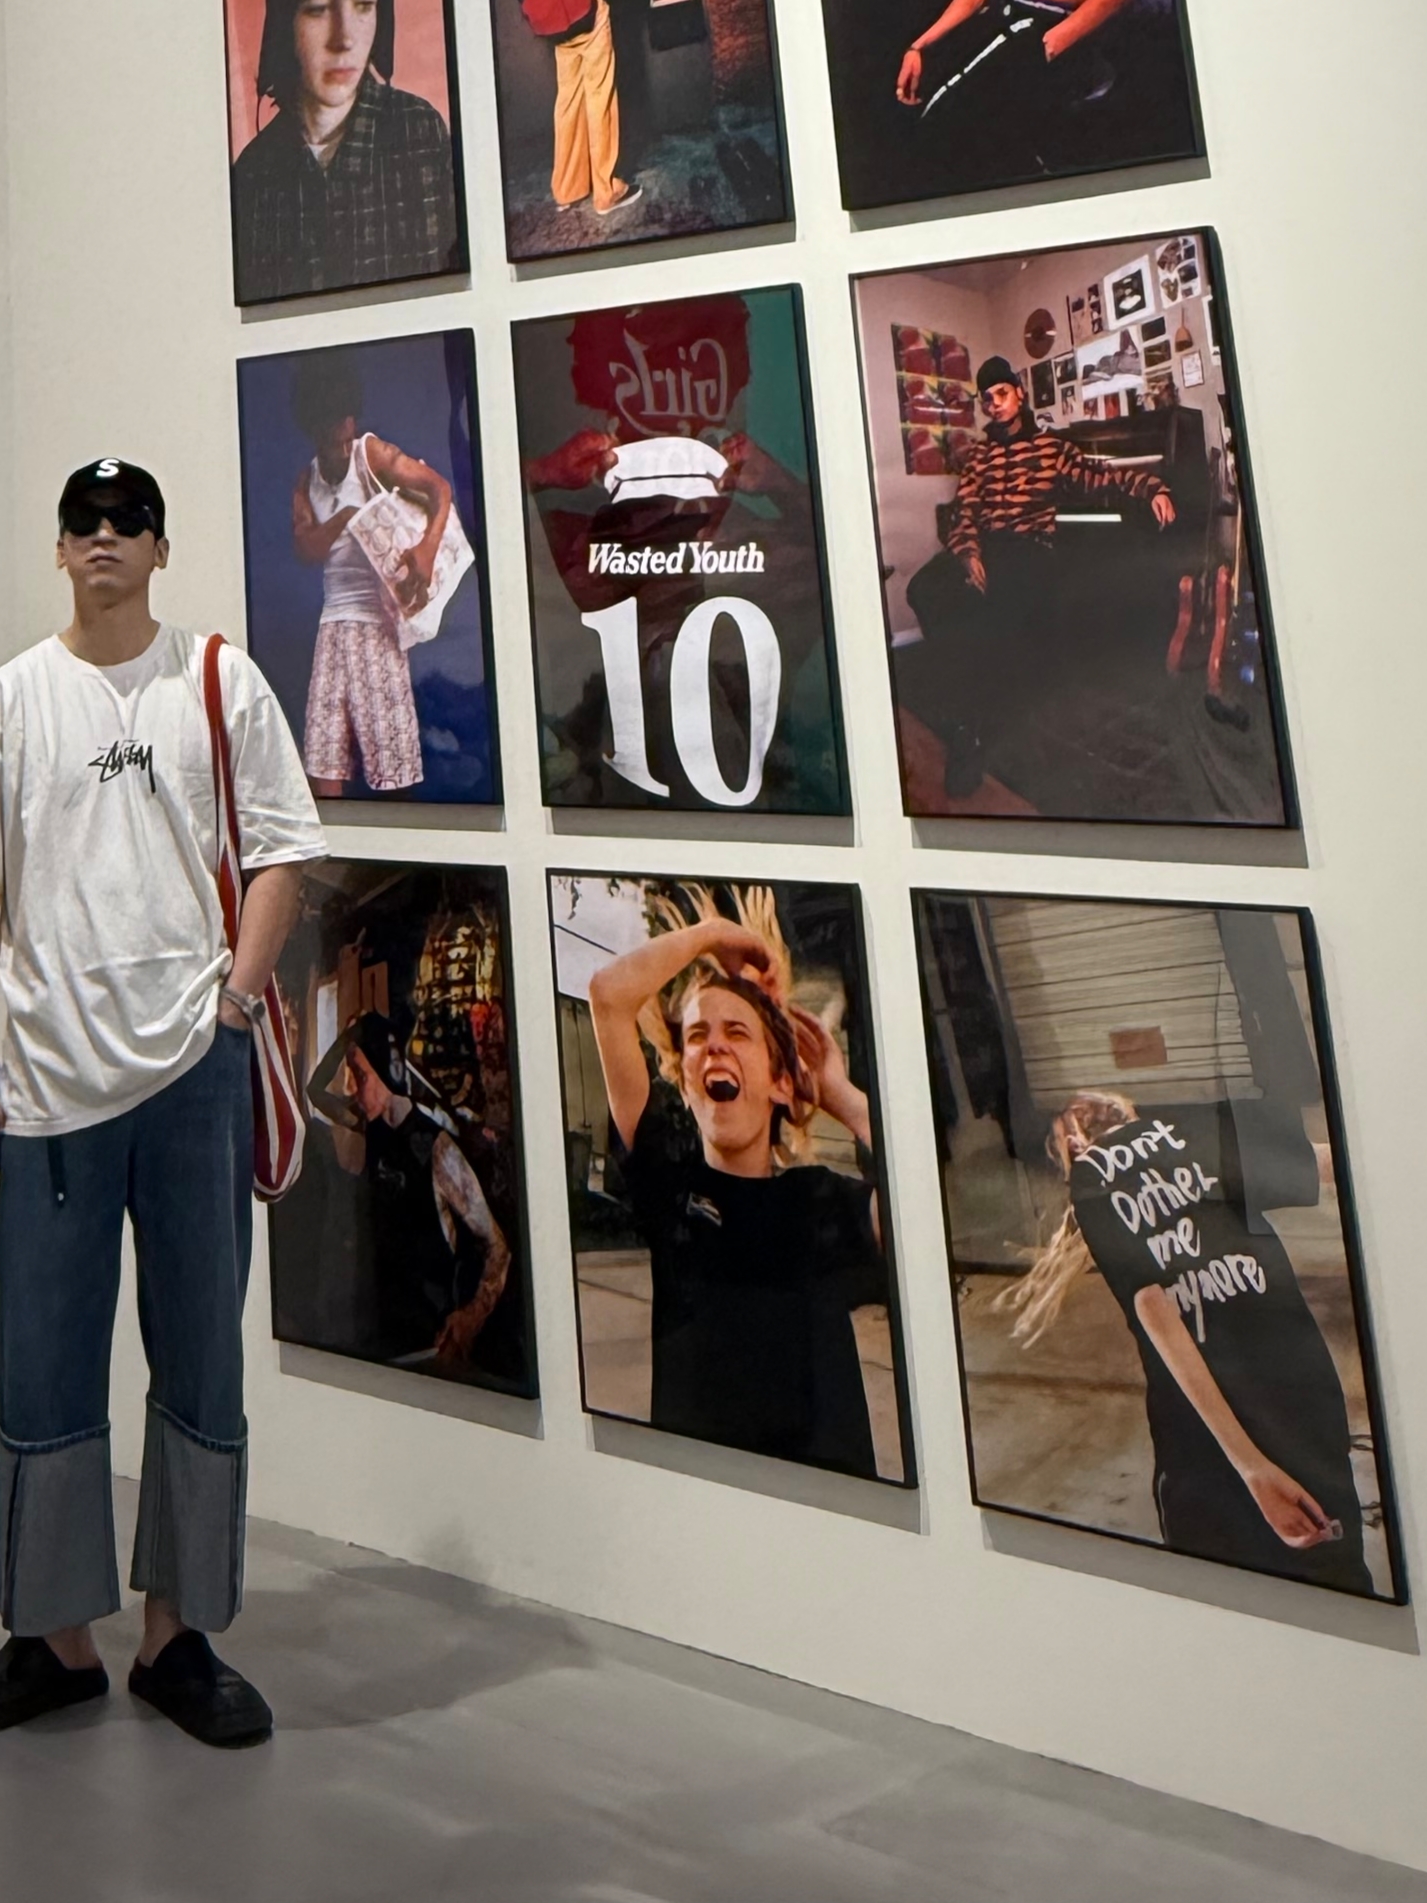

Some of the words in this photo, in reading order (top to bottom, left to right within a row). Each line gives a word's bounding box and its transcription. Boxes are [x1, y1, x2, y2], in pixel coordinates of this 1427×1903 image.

[96, 458, 120, 477] S
[588, 542, 687, 575] Wasted
[688, 541, 765, 574] Youth
[581, 596, 782, 806] 10
[1165, 1254, 1266, 1343] nymore
